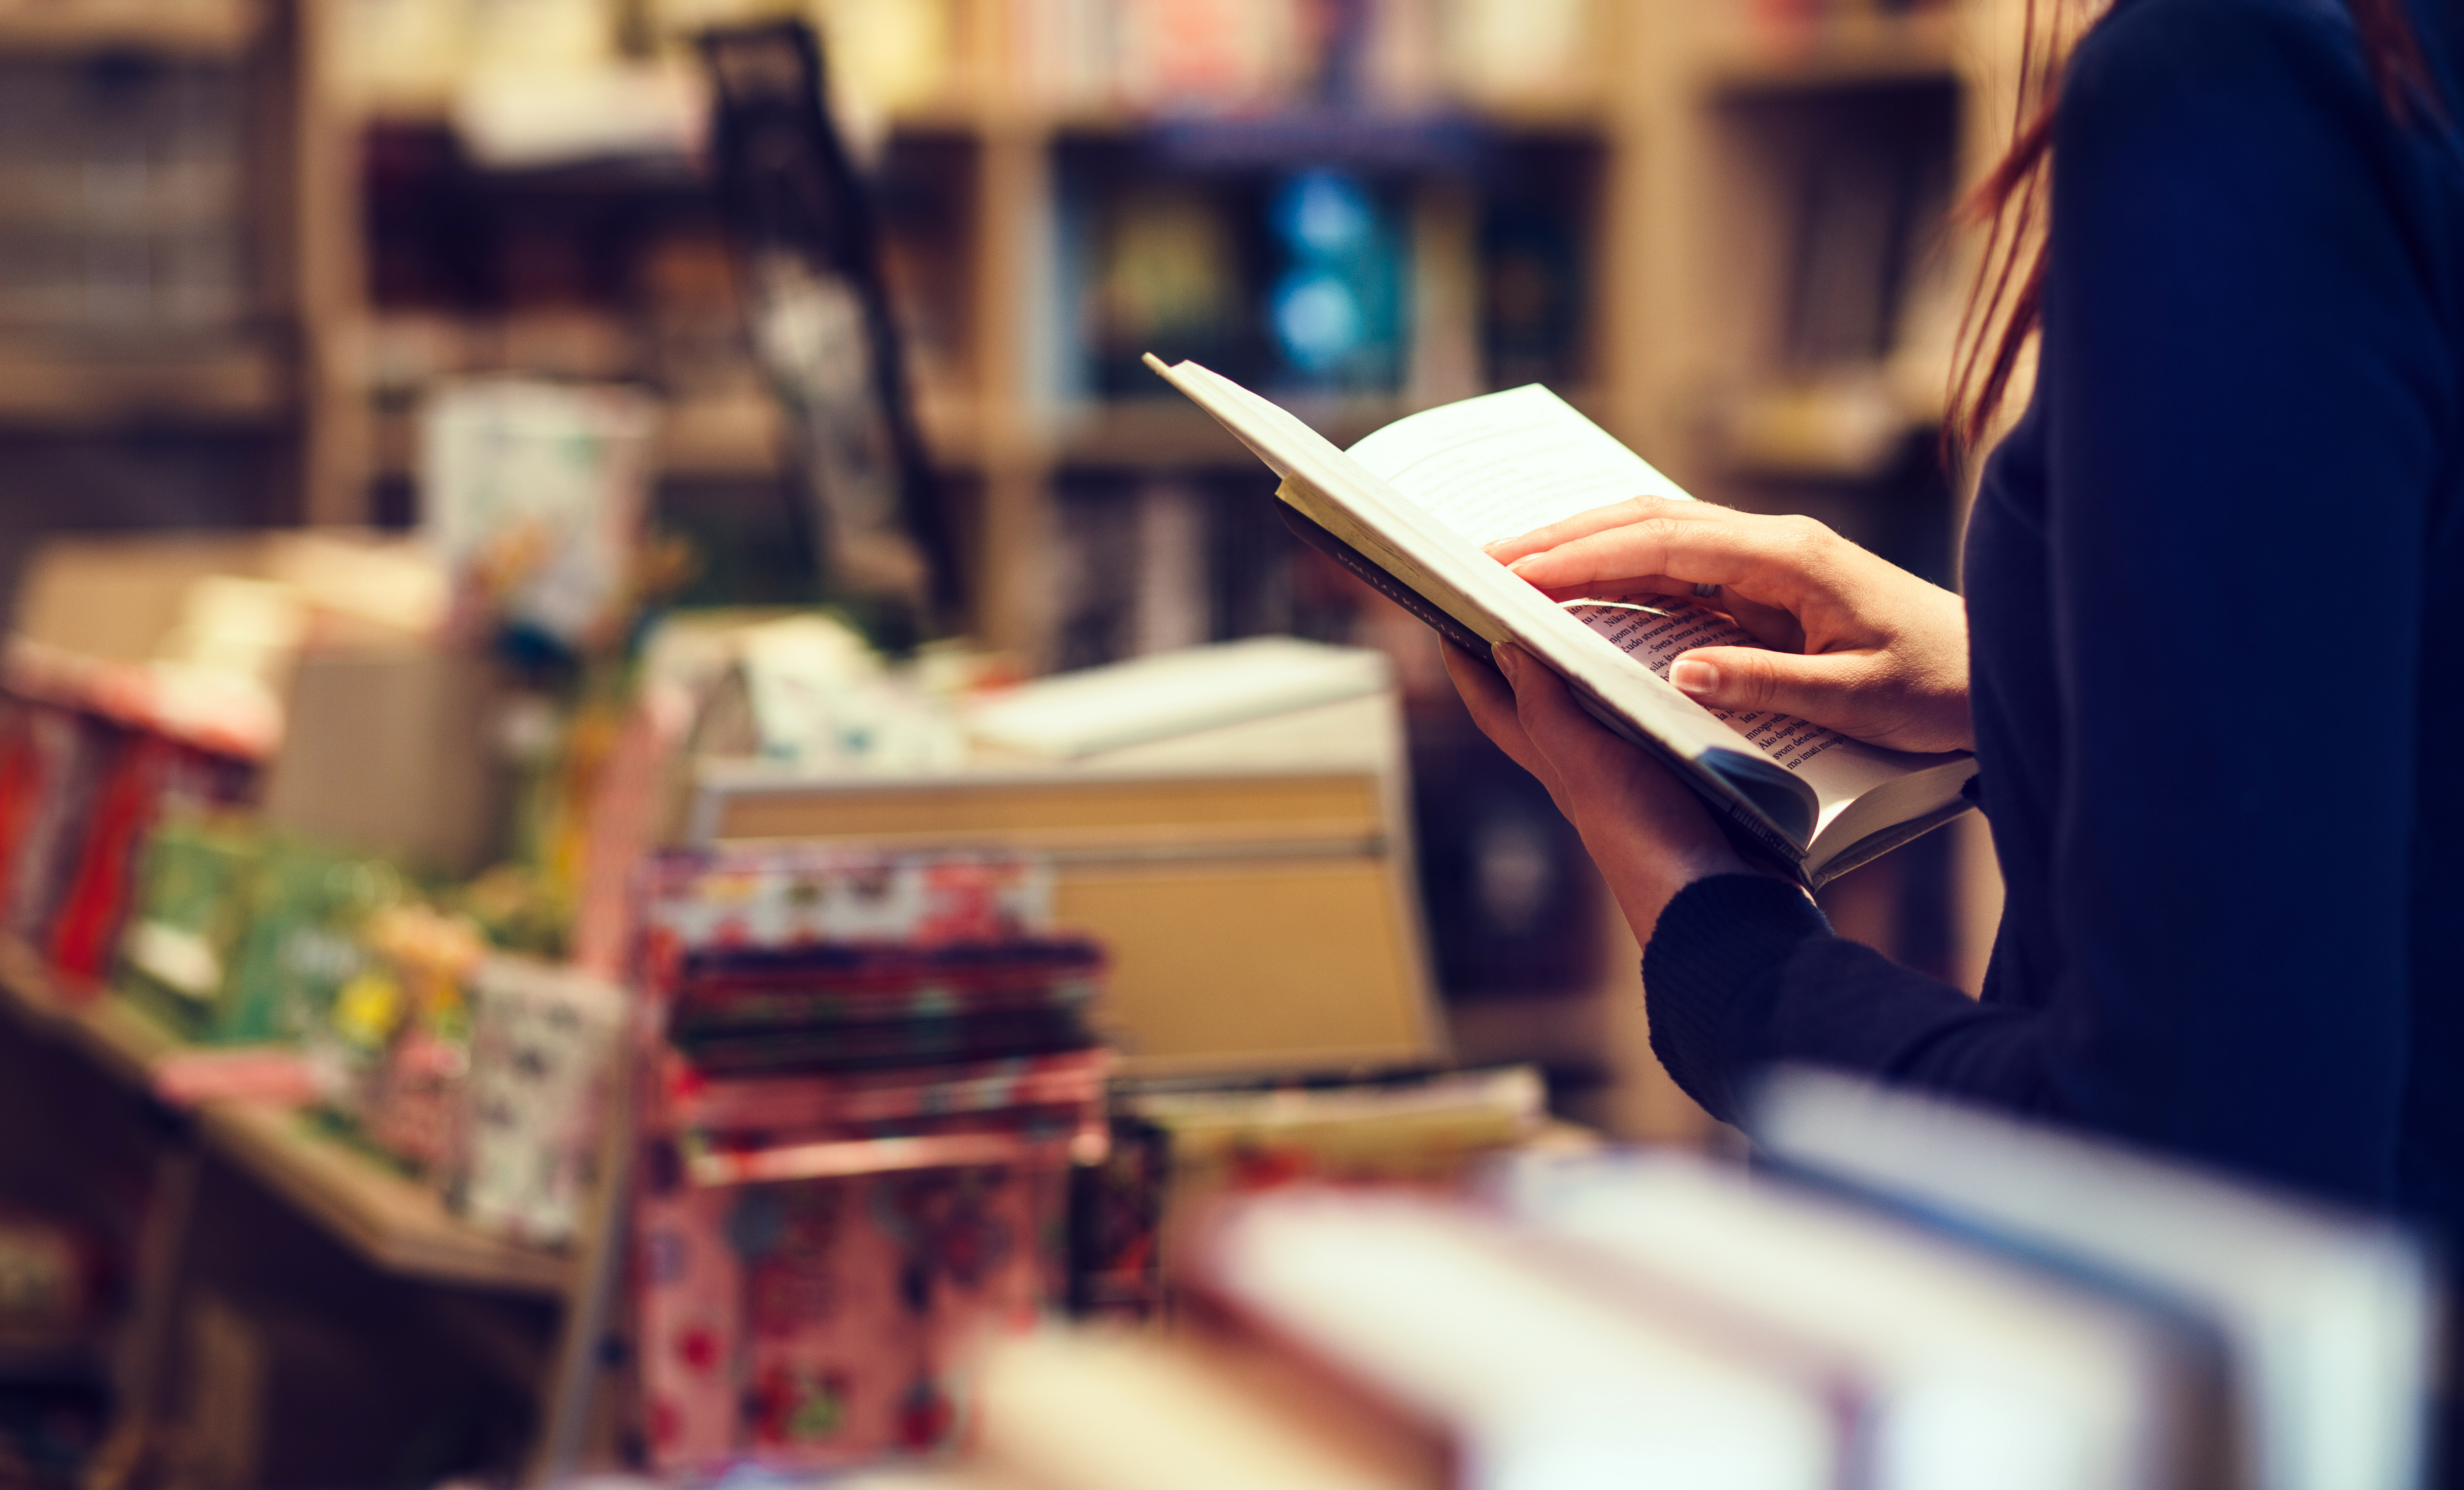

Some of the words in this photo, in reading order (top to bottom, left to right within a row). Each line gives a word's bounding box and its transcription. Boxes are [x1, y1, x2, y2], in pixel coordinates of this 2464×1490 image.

[1604, 615, 1626, 627] Niko
[1609, 628, 1631, 644] njom
[1627, 624, 1639, 633] je
[1633, 617, 1652, 628] bila
[1620, 637, 1644, 654] čudo
[1642, 621, 1676, 642] stvaranja
[1650, 638, 1673, 653] Sveta
[1668, 628, 1694, 643] Tereza
[1649, 660, 1668, 672] sila;
[1690, 635, 1713, 648] videla
[1739, 712, 1758, 724] Ista
[1744, 721, 1773, 741] mnogo
[1758, 738, 1777, 750] Ako
[1774, 725, 1795, 740] dugo
[1773, 744, 1795, 760] svom
[1791, 730, 1820, 747] detetu,
[1786, 758, 1802, 770] mo
[1798, 745, 1821, 761] imati
[1819, 734, 1844, 750] mnogo
